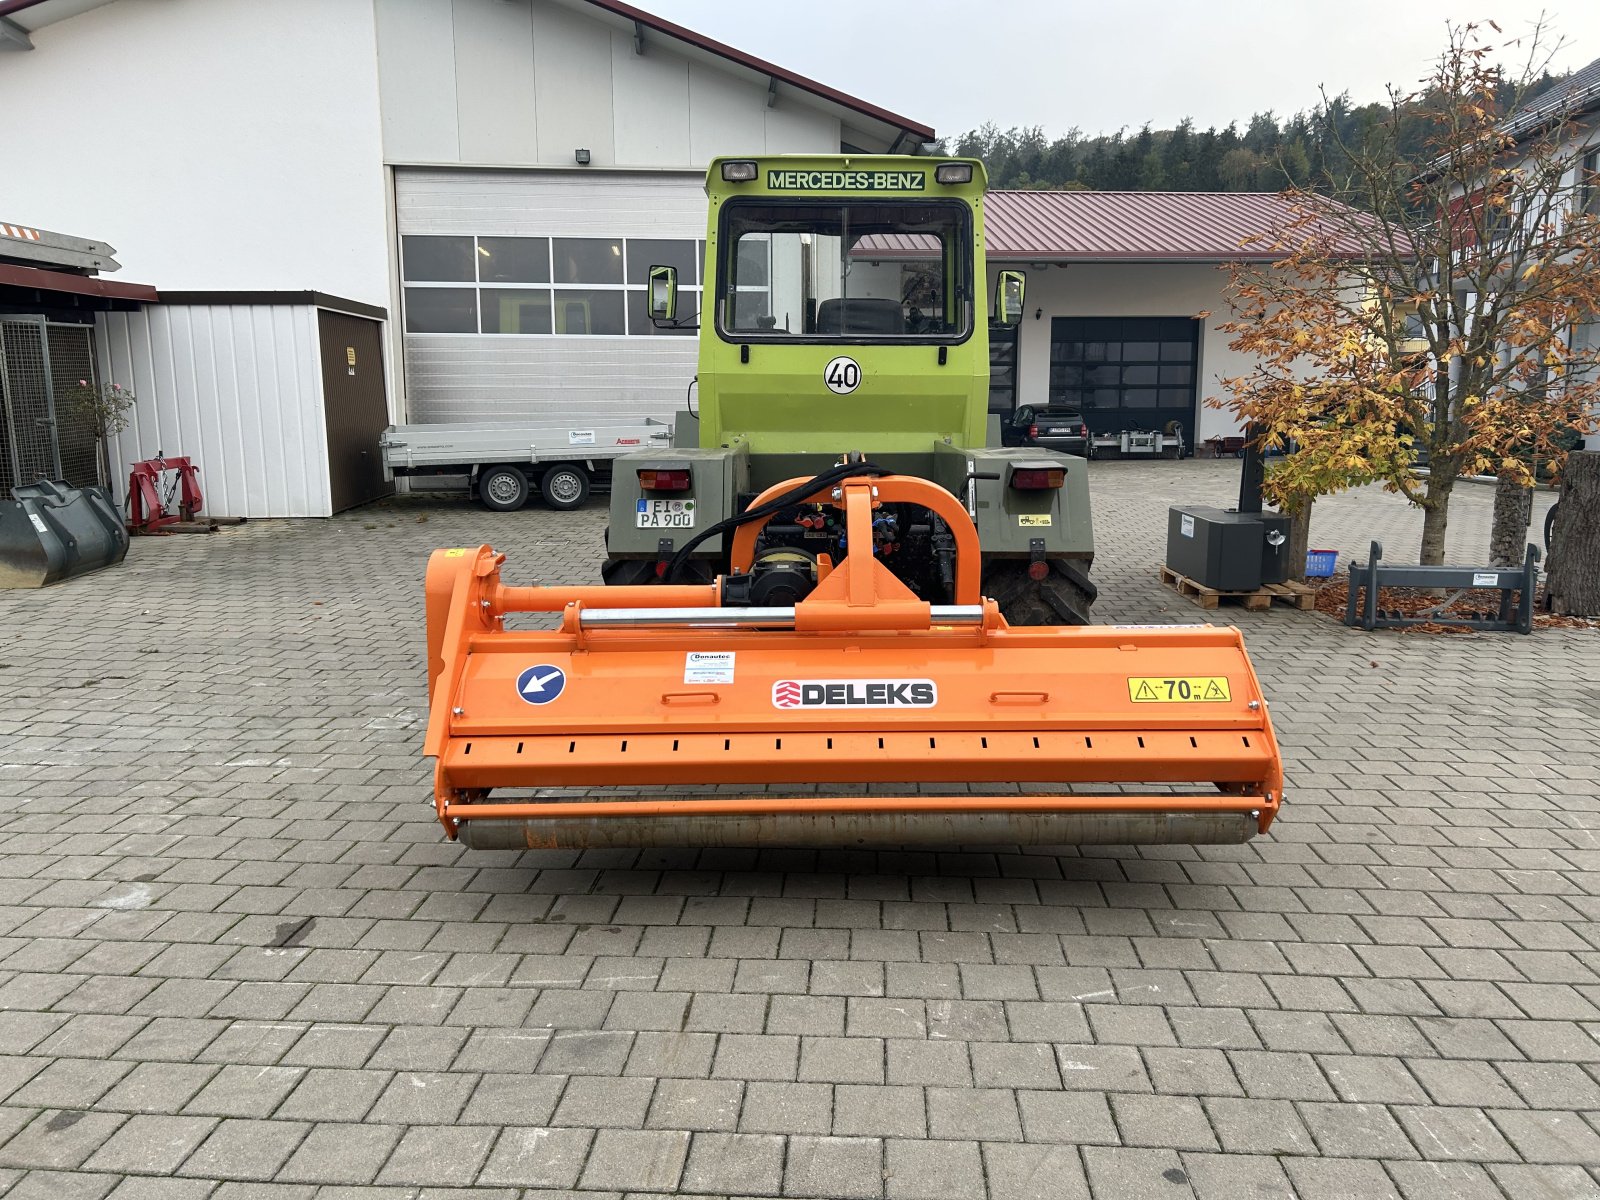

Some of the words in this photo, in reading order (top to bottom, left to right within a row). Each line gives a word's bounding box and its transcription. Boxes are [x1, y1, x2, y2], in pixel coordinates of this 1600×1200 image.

[769, 172, 923, 189] MERCEDES-BENZ
[828, 363, 857, 388] 40
[653, 500, 671, 513] EI
[640, 514, 659, 526] PA
[664, 514, 691, 526] 900
[802, 683, 934, 705] DELEKS
[1163, 680, 1191, 700] 70
